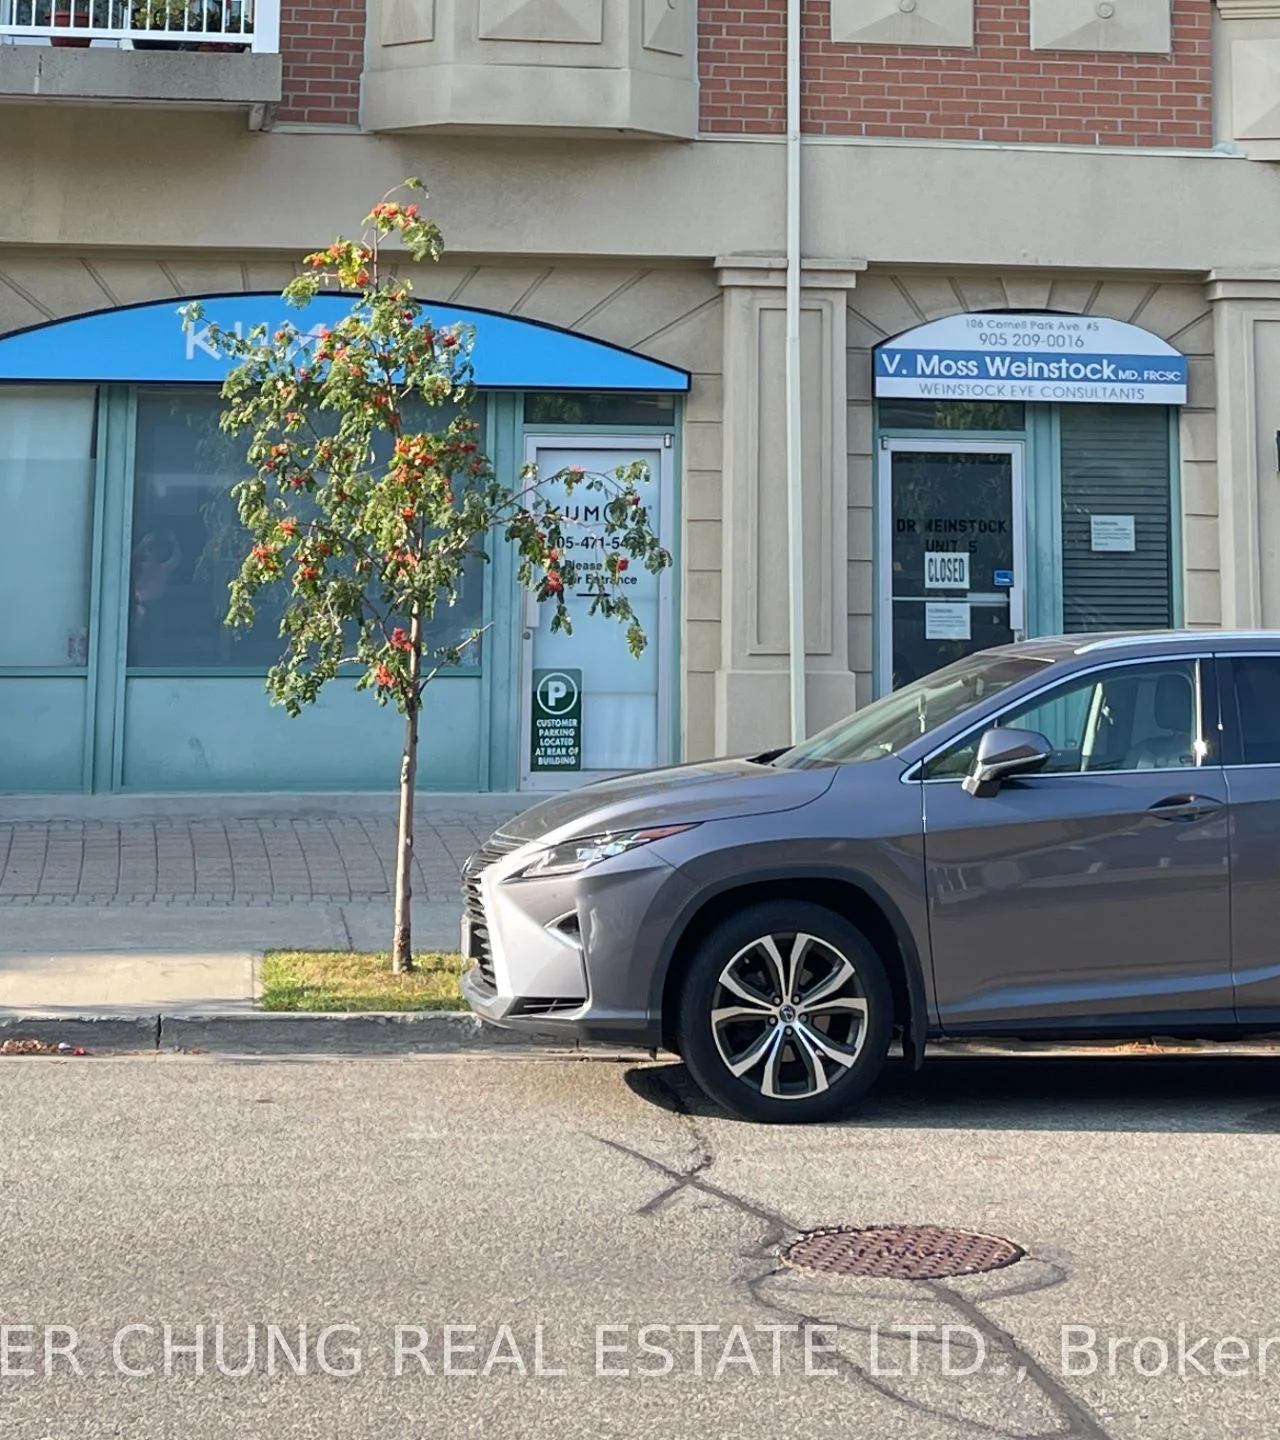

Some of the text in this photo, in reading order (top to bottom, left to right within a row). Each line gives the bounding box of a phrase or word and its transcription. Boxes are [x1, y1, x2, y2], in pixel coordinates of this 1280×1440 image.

[1030, 320, 1054, 330] Park
[979, 332, 1085, 348] 905 209-0016
[881, 353, 908, 375] V.
[916, 354, 979, 377] Moss
[984, 356, 1117, 380] Weinstock
[1143, 369, 1181, 382] FRCSC
[919, 383, 1145, 400] WEINSTOCK EYE CONSULTANTS
[896, 519, 916, 533] DR
[928, 557, 965, 583] CLOSED
[548, 681, 567, 707] P
[536, 719, 578, 728] CUSTOMER
[538, 728, 575, 737] PARKING
[539, 738, 574, 747] LOCATED
[535, 747, 579, 756] AT REAR OF
[537, 757, 576, 766] BUILDING
